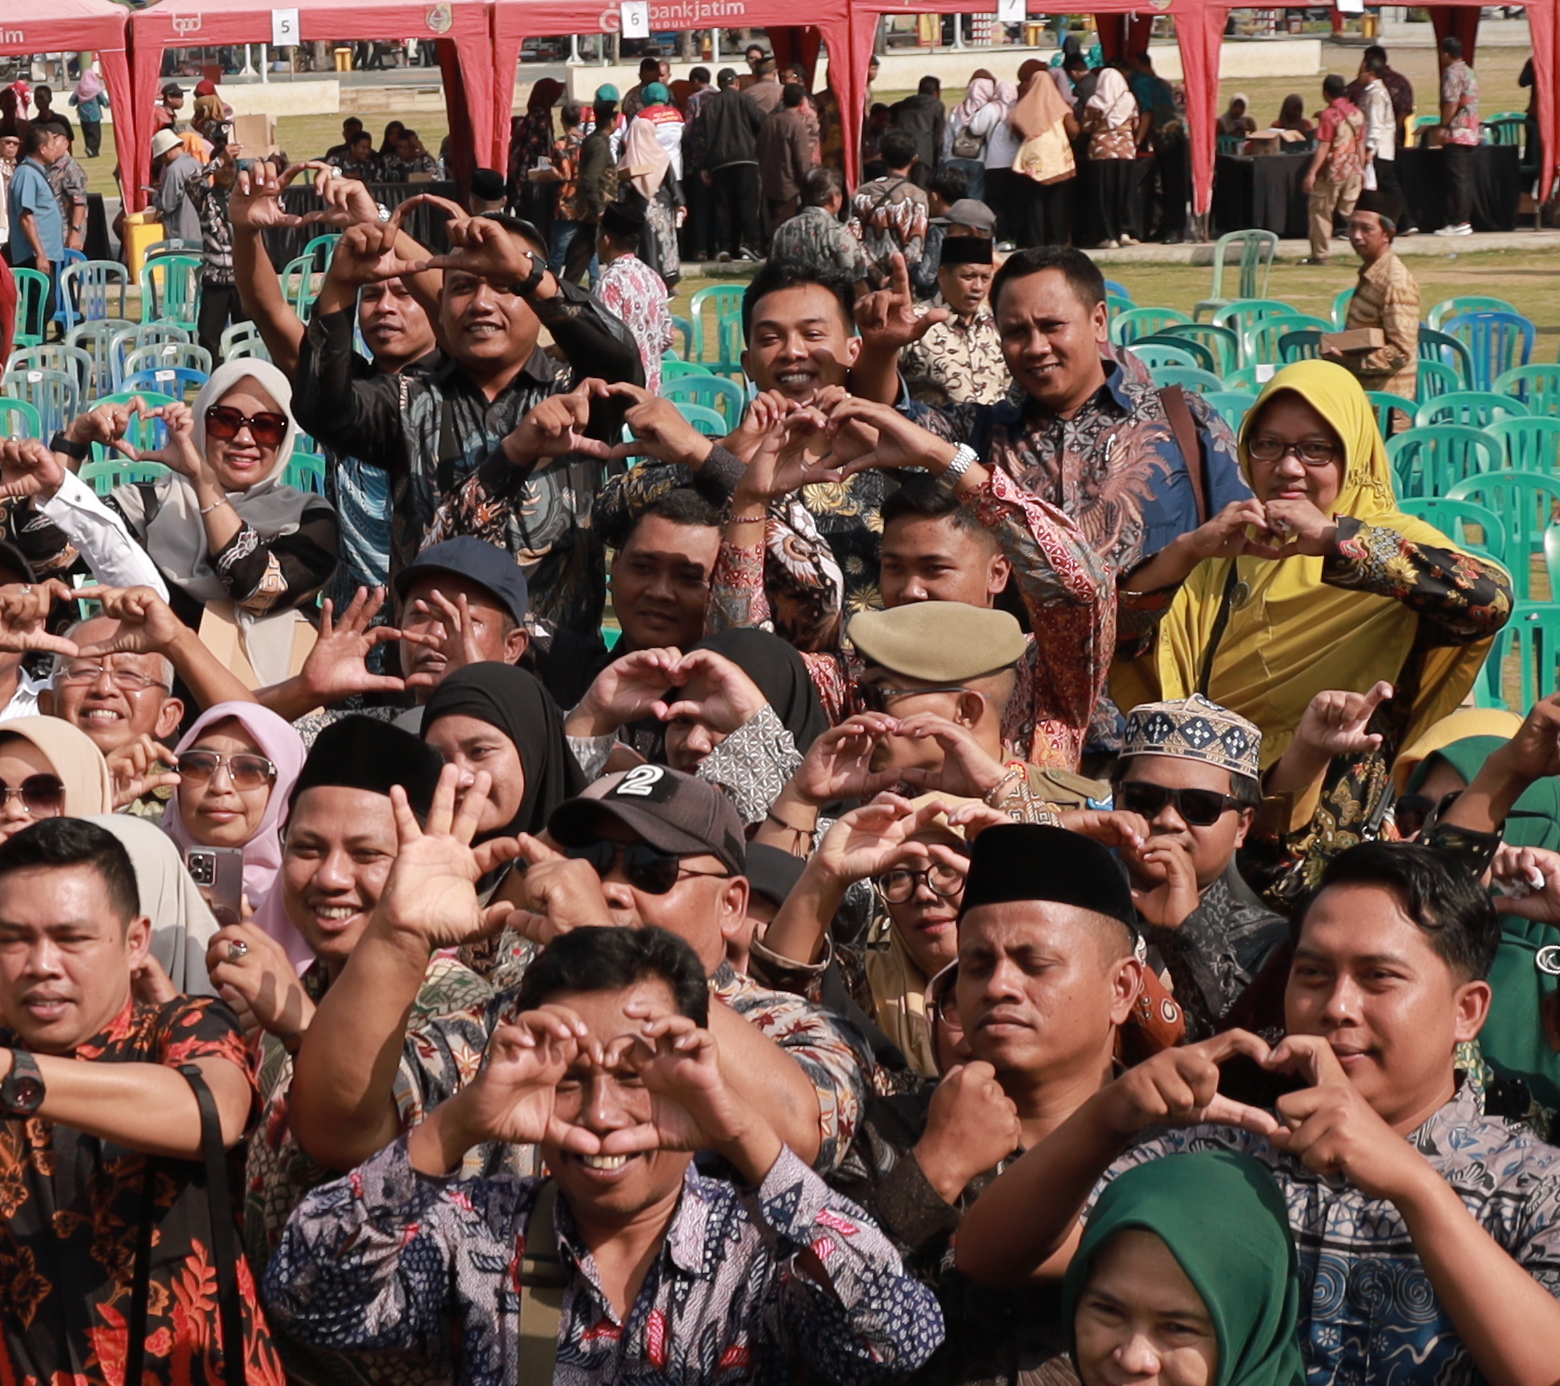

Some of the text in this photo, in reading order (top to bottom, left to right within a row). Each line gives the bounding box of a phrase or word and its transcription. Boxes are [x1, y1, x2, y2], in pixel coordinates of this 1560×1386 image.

[631, 13, 640, 26] 6
[280, 20, 290, 34] 5
[617, 764, 664, 796] 2
